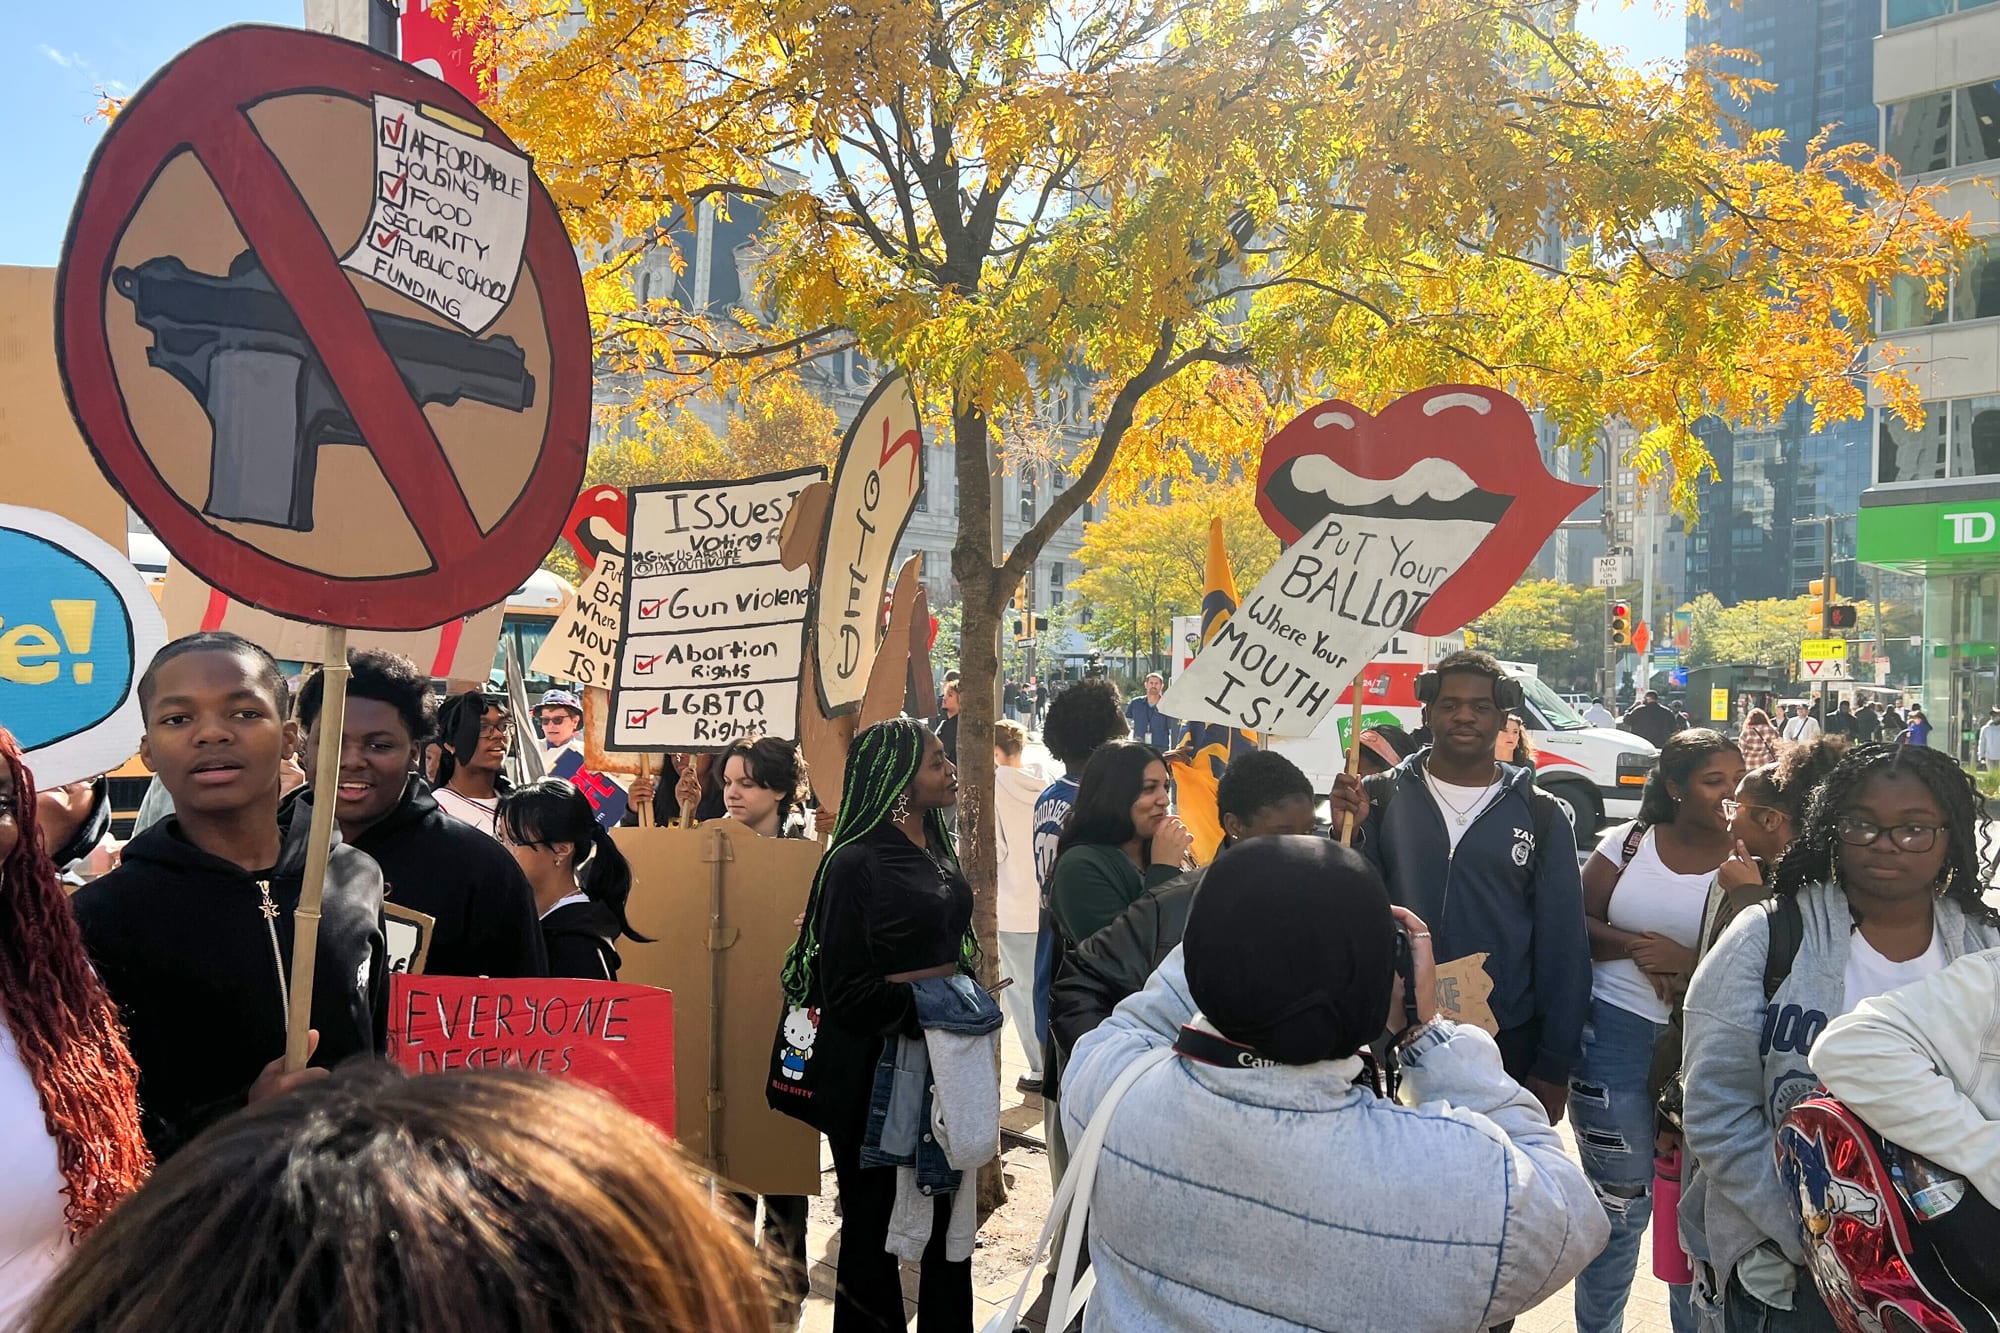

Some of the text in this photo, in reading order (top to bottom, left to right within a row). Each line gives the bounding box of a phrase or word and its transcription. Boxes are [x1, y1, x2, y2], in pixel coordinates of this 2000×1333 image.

[395, 153, 479, 204] HOUSING
[409, 128, 525, 200] AFFORDABLE
[382, 204, 490, 261] SECURITY
[409, 186, 471, 227] FOOD
[373, 256, 461, 320] FUNDING
[398, 235, 508, 304] PUBLIC SCHOOL
[1943, 512, 1995, 544] TD
[1389, 535, 1448, 588] Your
[1600, 558, 1616, 567] NO
[577, 595, 617, 630] Where
[668, 587, 728, 619] Gun
[1281, 555, 1431, 629] BALLOT
[0, 599, 97, 685] e!
[665, 641, 778, 665] Abortion
[1248, 595, 1347, 668] Where Your
[691, 663, 751, 681] Rights
[1212, 621, 1330, 717] MOUTH
[661, 688, 765, 716] LGBTQ
[1204, 671, 1284, 731] IS!
[693, 718, 767, 742] Rights
[406, 989, 629, 1046] EVERYONE
